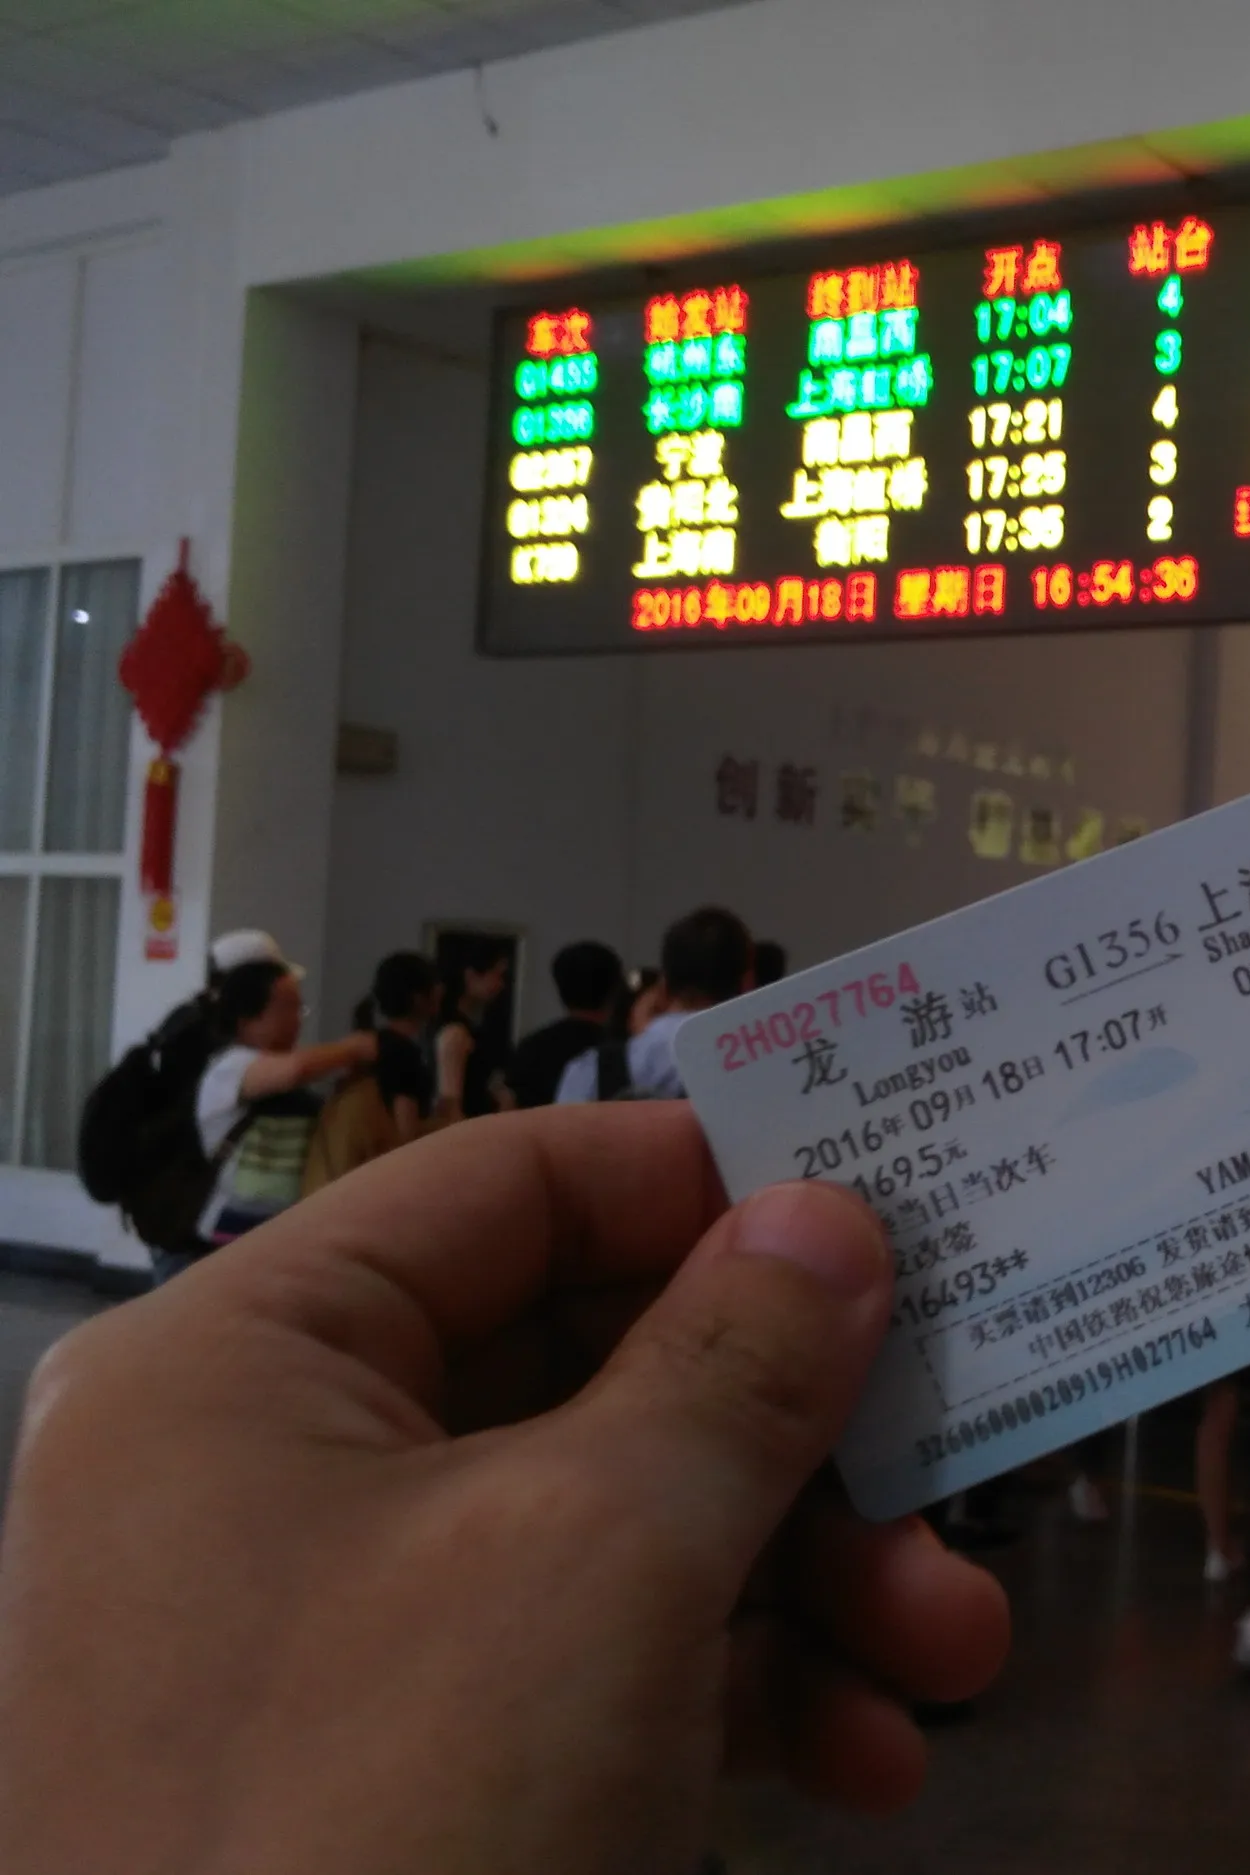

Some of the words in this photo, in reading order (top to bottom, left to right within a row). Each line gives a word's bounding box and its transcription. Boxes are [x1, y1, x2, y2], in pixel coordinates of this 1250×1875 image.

[984, 239, 1062, 297] 开点
[1129, 215, 1214, 275] 站台
[973, 290, 1072, 343] 17:04
[1156, 273, 1183, 318] 4
[785, 353, 934, 419] 上海虹桥
[972, 343, 1071, 396] 17:07
[1155, 328, 1183, 375] 3
[968, 397, 1063, 448] 17:21
[1151, 384, 1179, 429] 4
[966, 450, 1067, 501] 17:25
[1148, 438, 1178, 486] 3
[964, 504, 1066, 556] 17:35
[1146, 494, 1174, 541] 2
[631, 571, 877, 631] 2016年09月18日
[893, 563, 1007, 619] 星期日
[1043, 910, 1182, 992] G1356
[715, 962, 921, 1072] 2H027764
[851, 1042, 973, 1107] Longyou
[968, 1255, 1147, 1351] 买票请到12306
